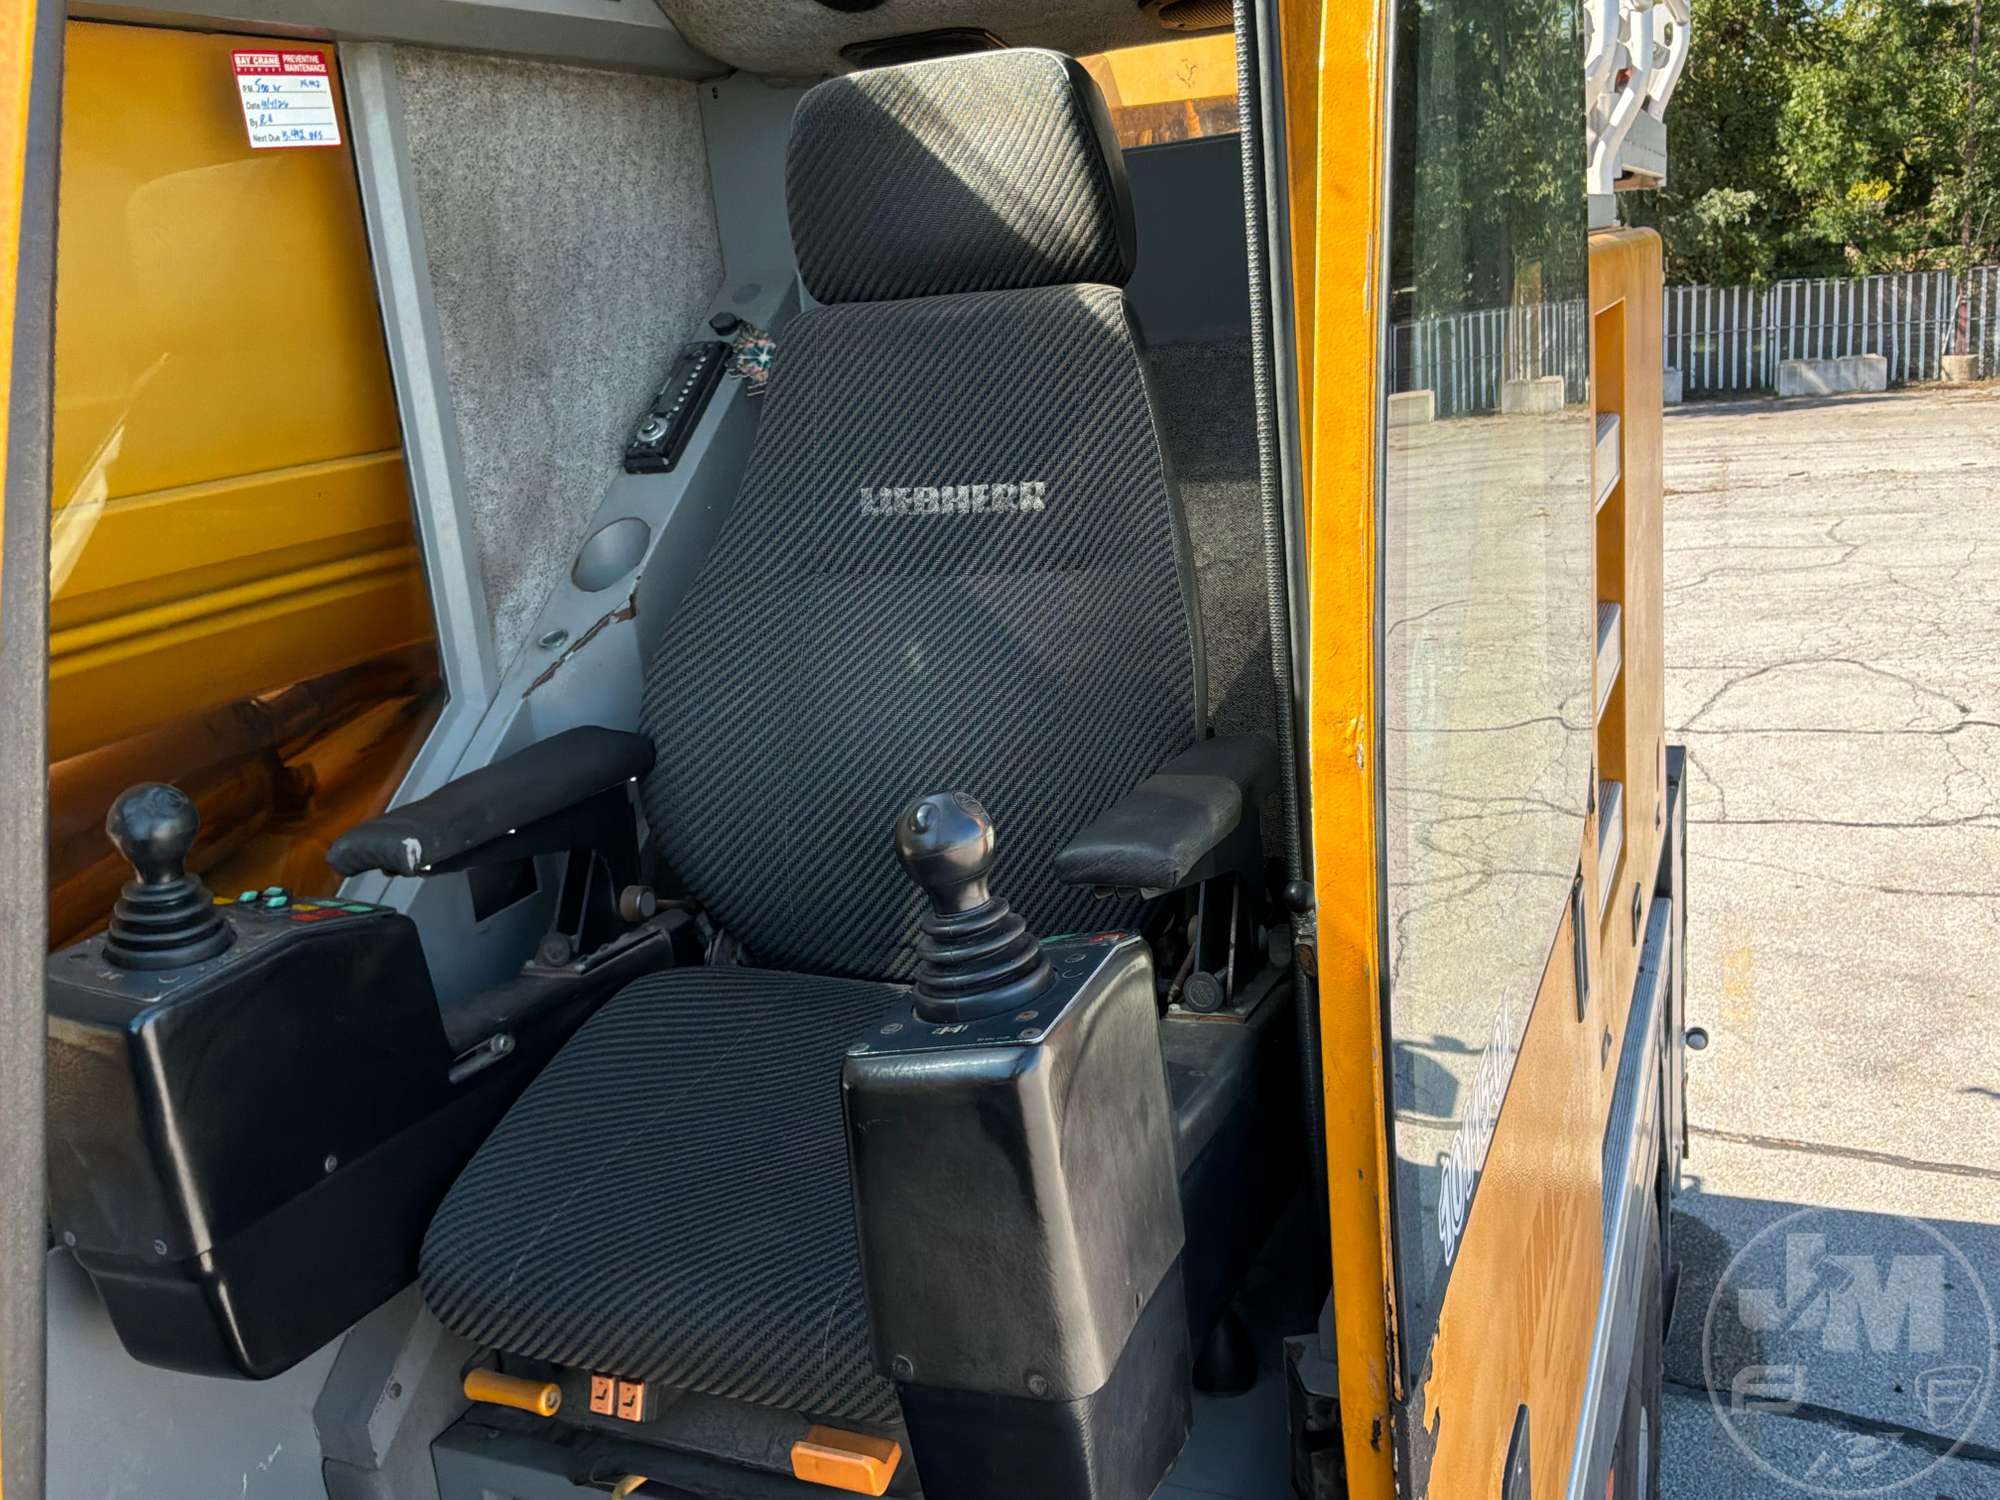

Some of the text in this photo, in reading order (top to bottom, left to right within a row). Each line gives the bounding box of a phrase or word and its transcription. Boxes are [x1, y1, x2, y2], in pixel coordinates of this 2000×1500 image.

[253, 55, 280, 65] CRANE
[282, 54, 319, 64] PREVENTIVE
[284, 63, 326, 72] MAINTENANCE
[246, 101, 260, 109] Date
[249, 118, 258, 128] By
[253, 134, 281, 143] Next Due
[860, 481, 1046, 516] LIEBHERR
